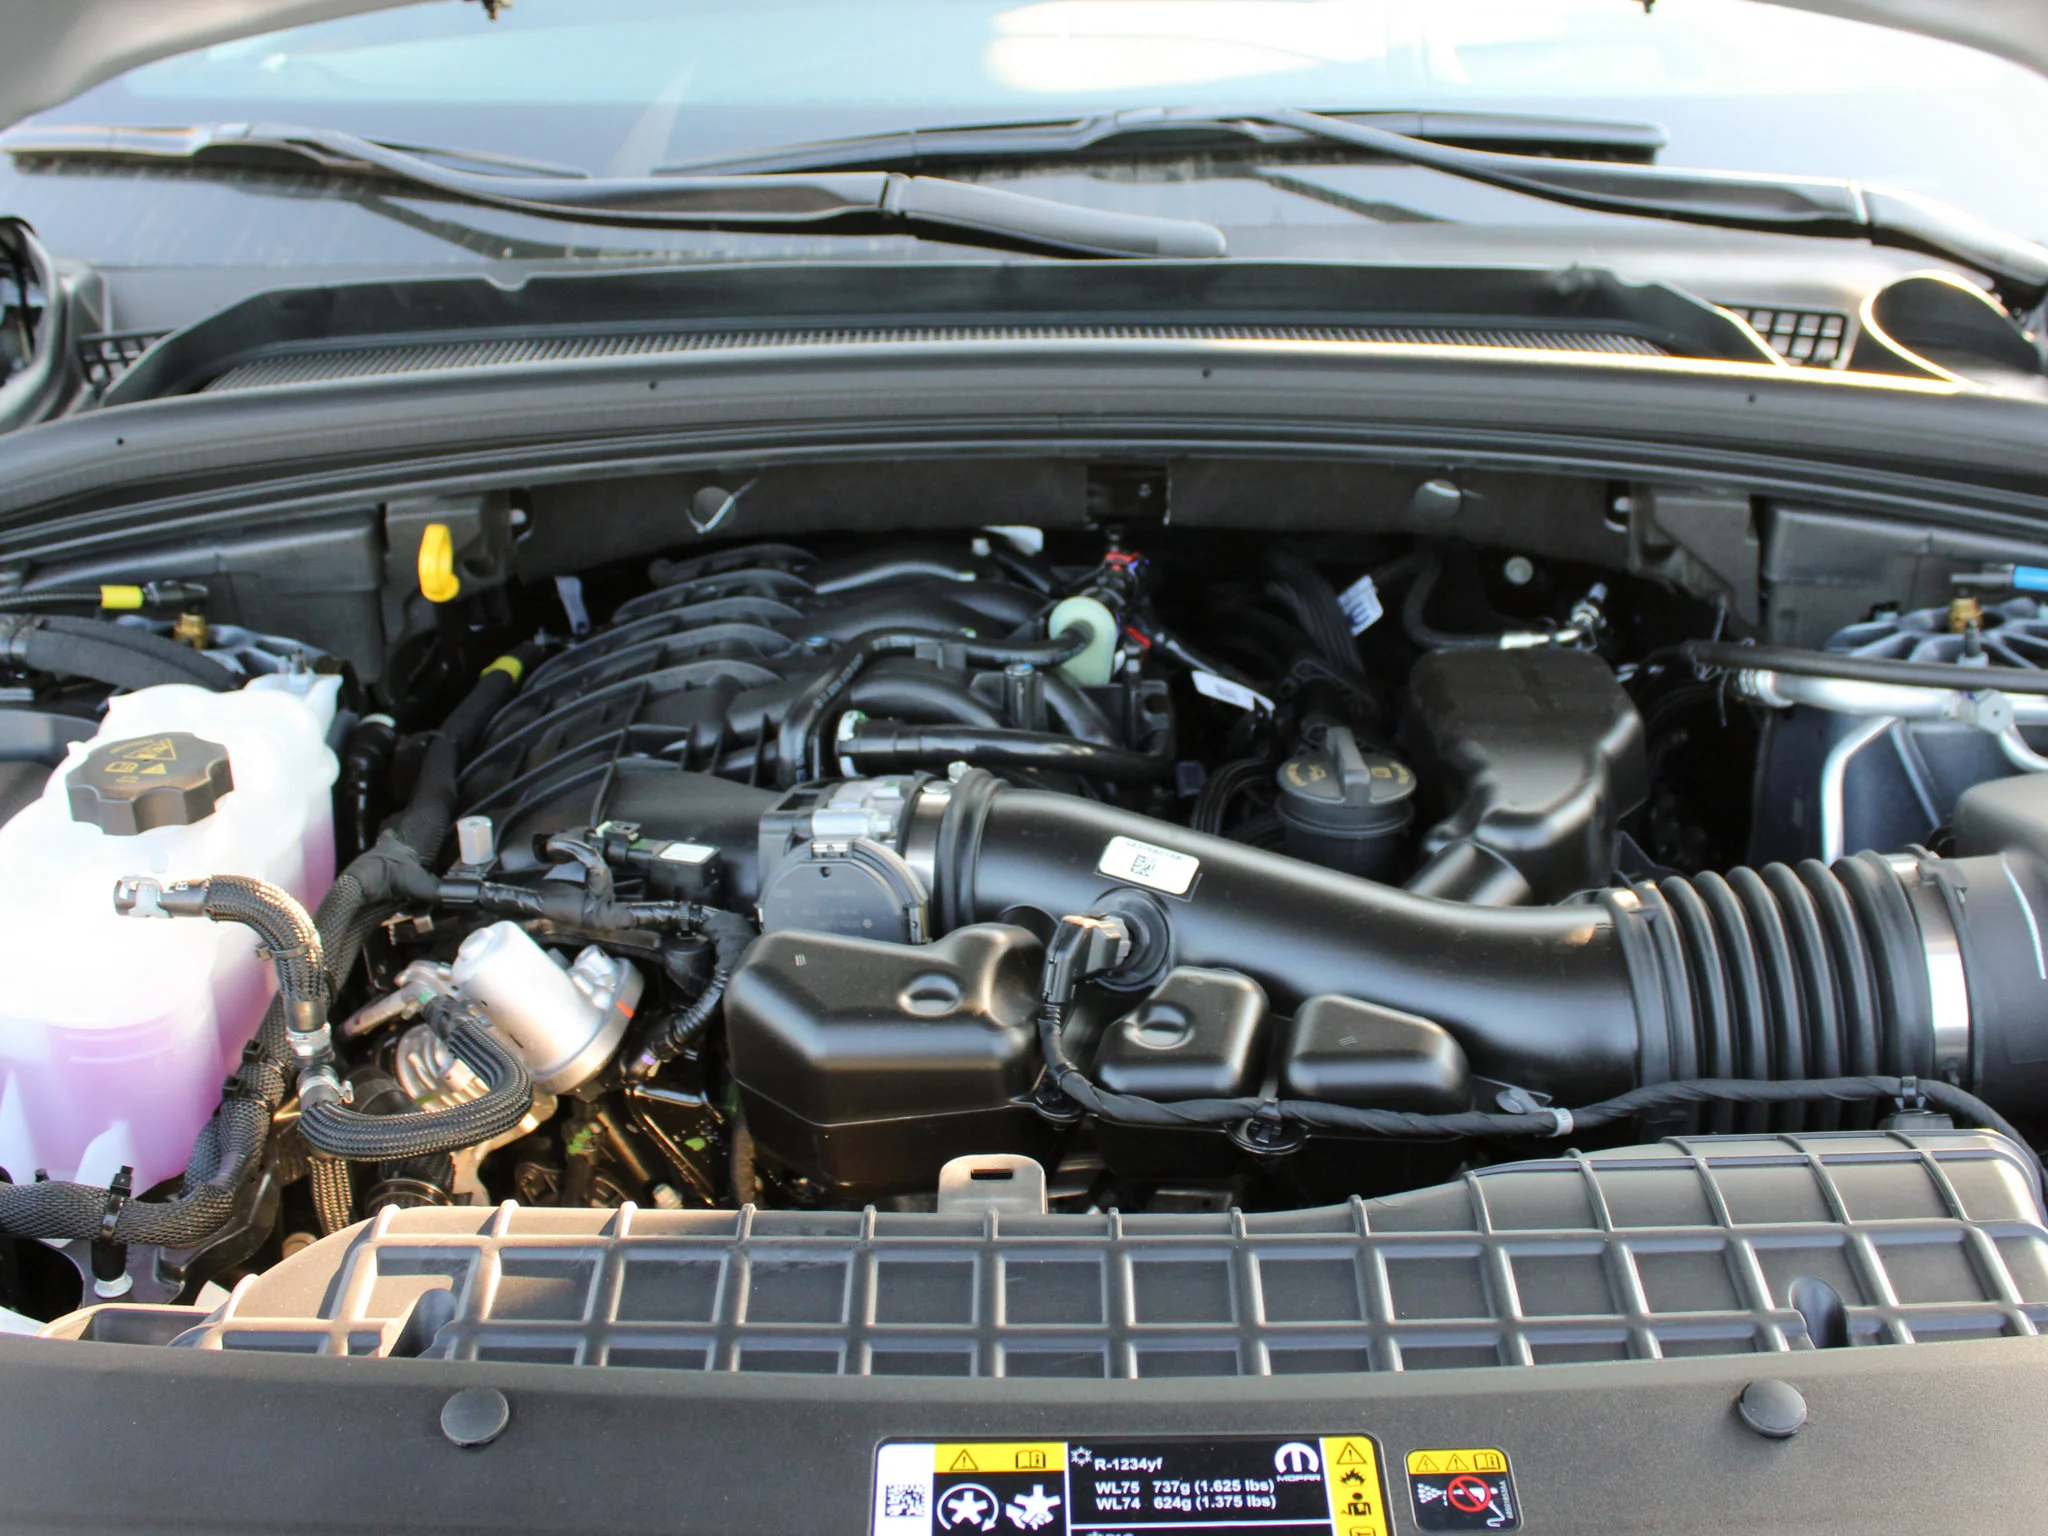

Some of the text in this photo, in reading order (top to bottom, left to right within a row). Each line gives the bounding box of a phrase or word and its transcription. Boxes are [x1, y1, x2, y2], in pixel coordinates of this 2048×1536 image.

[1094, 1456, 1163, 1473] R-1234yf
[1276, 1474, 1321, 1482] MOPAR
[1095, 1478, 1275, 1496] WL75 737g (1.625 lbs)
[1095, 1494, 1277, 1512] WL74 624g (1.375 lbs)
